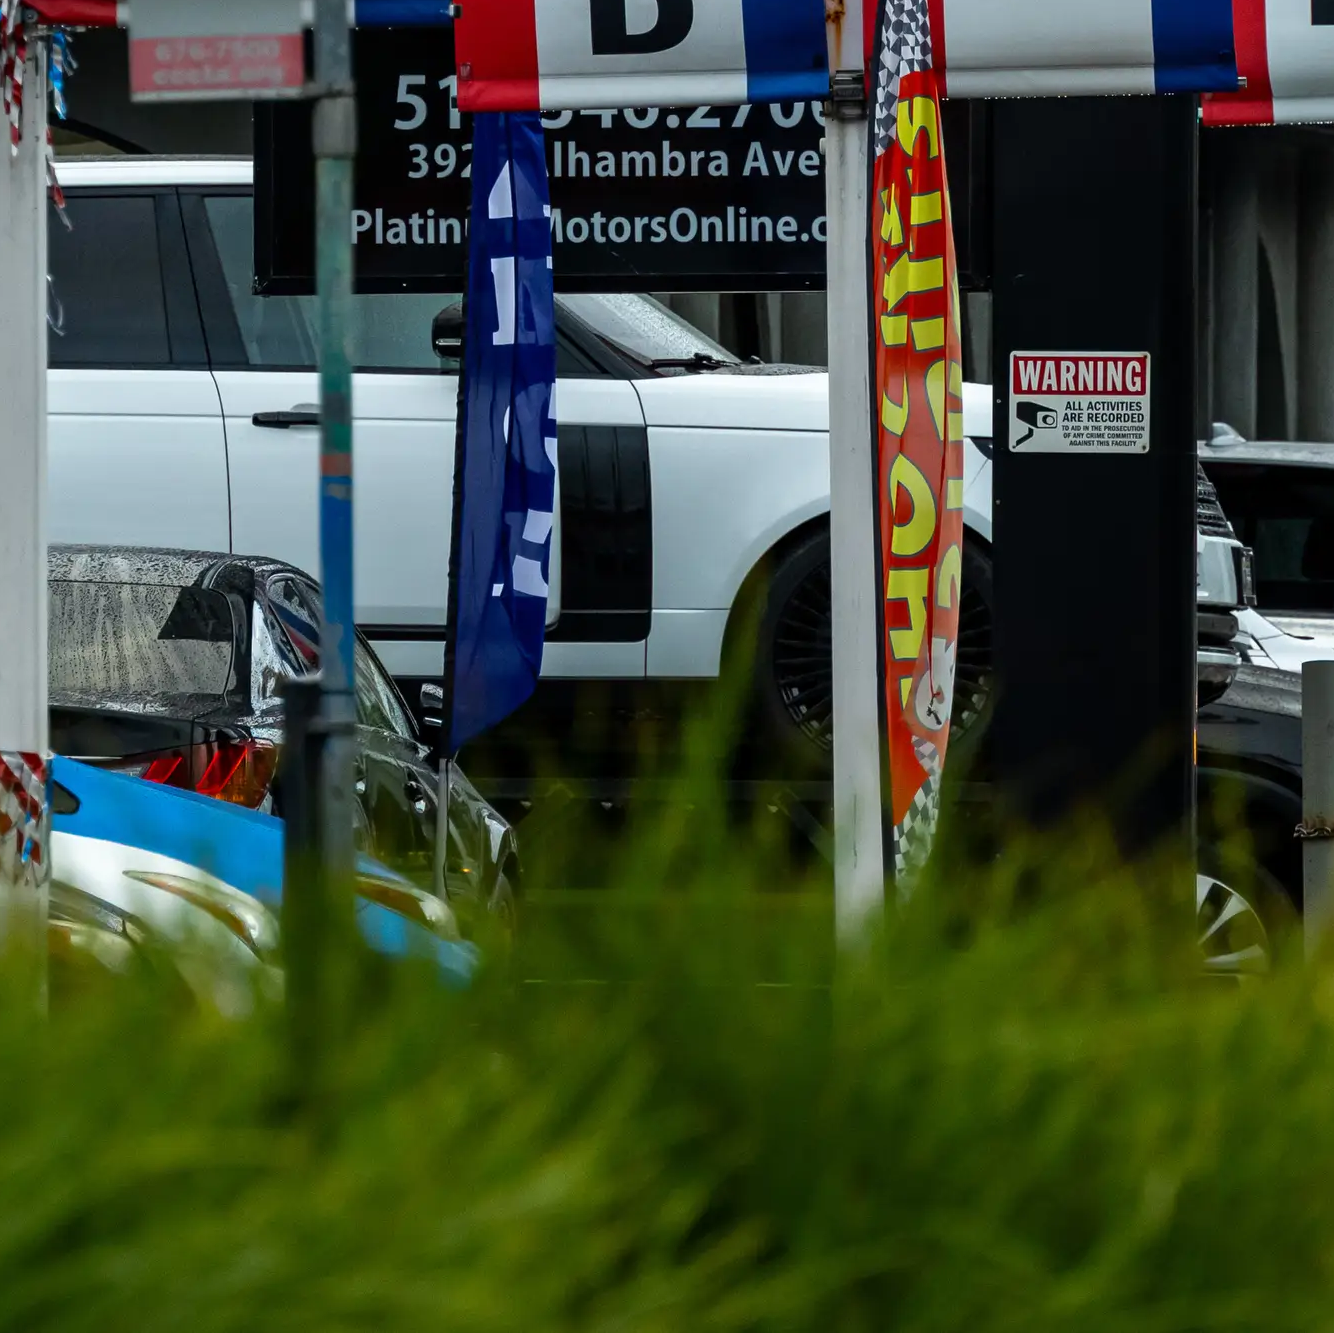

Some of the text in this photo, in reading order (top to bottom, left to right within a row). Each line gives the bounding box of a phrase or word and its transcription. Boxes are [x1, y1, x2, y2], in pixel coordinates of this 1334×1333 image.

[544, 140, 729, 178] lhambra
[1018, 360, 1142, 392] WARNING
[1064, 401, 1142, 411] ALL ACTIVITIES
[1062, 412, 1144, 423] ARE RECORDED
